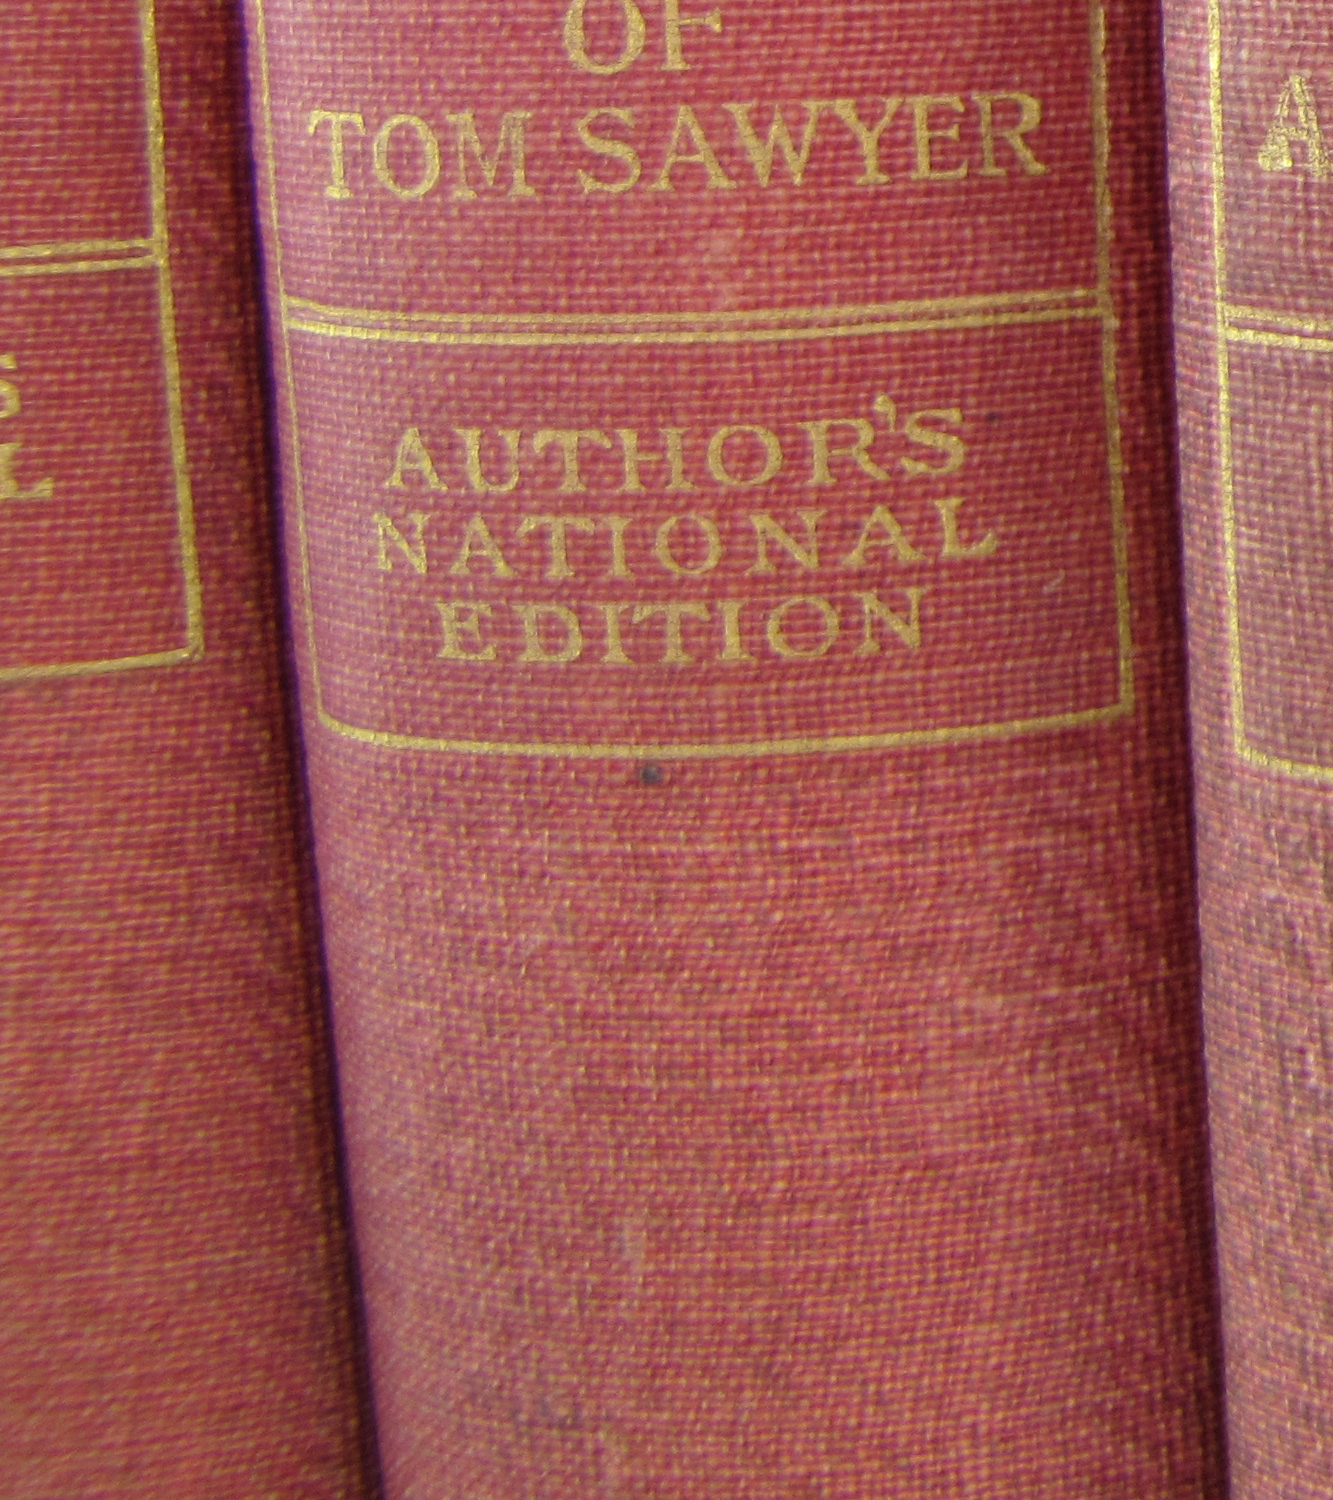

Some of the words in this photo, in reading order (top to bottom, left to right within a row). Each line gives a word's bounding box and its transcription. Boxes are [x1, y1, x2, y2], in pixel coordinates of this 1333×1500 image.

[308, 109, 537, 198] TOM
[578, 91, 1049, 194] SAWYER
[384, 394, 966, 493] AUTHOR'S
[372, 499, 999, 580] NATIONAL
[437, 587, 926, 663] EDITION
